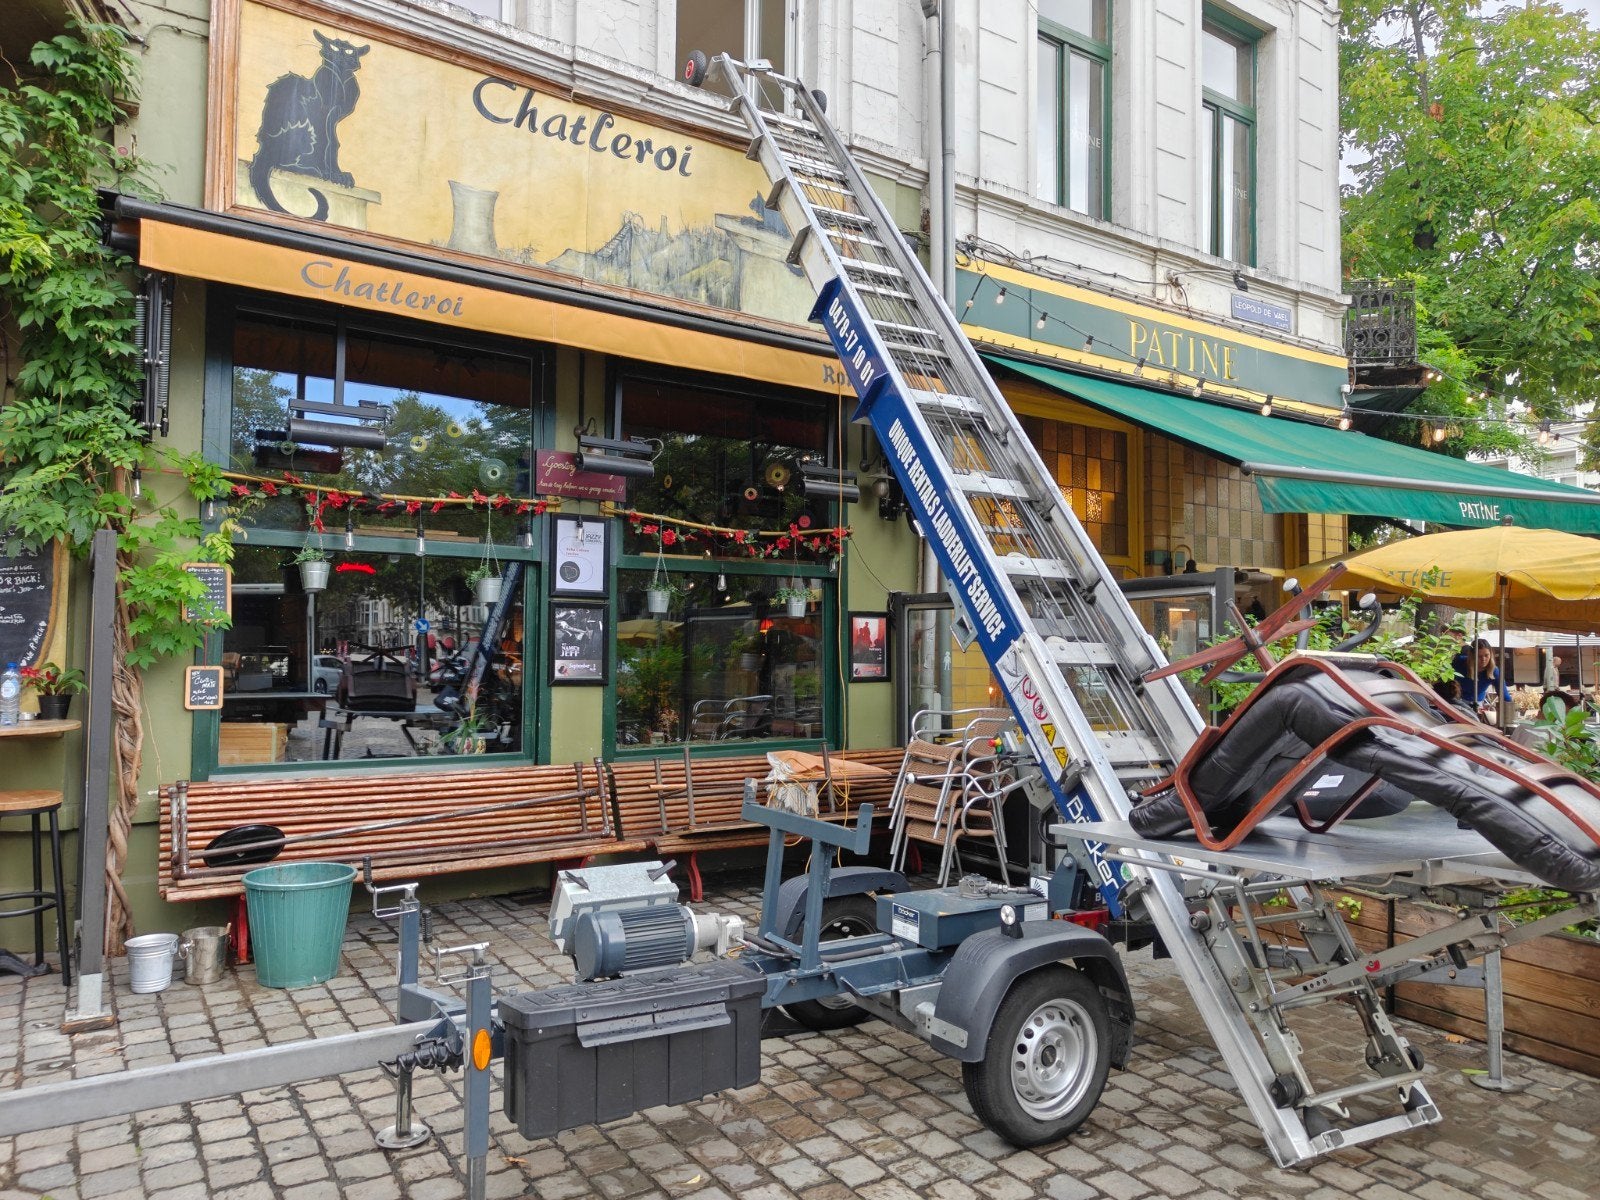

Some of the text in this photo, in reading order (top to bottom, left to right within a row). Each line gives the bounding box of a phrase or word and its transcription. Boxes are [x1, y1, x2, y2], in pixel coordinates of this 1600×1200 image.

[472, 76, 693, 178] Chatleroi
[301, 261, 464, 317] Chatleroi
[1234, 300, 1289, 322] LEOPOLD DE WAEL
[852, 345, 867, 370] 10
[860, 360, 875, 387] 01
[1128, 319, 1241, 381] PATINE
[888, 417, 1006, 643] UNIQUE RENTALS LADDERLIFT SERVICE
[1458, 500, 1501, 521] PATINE
